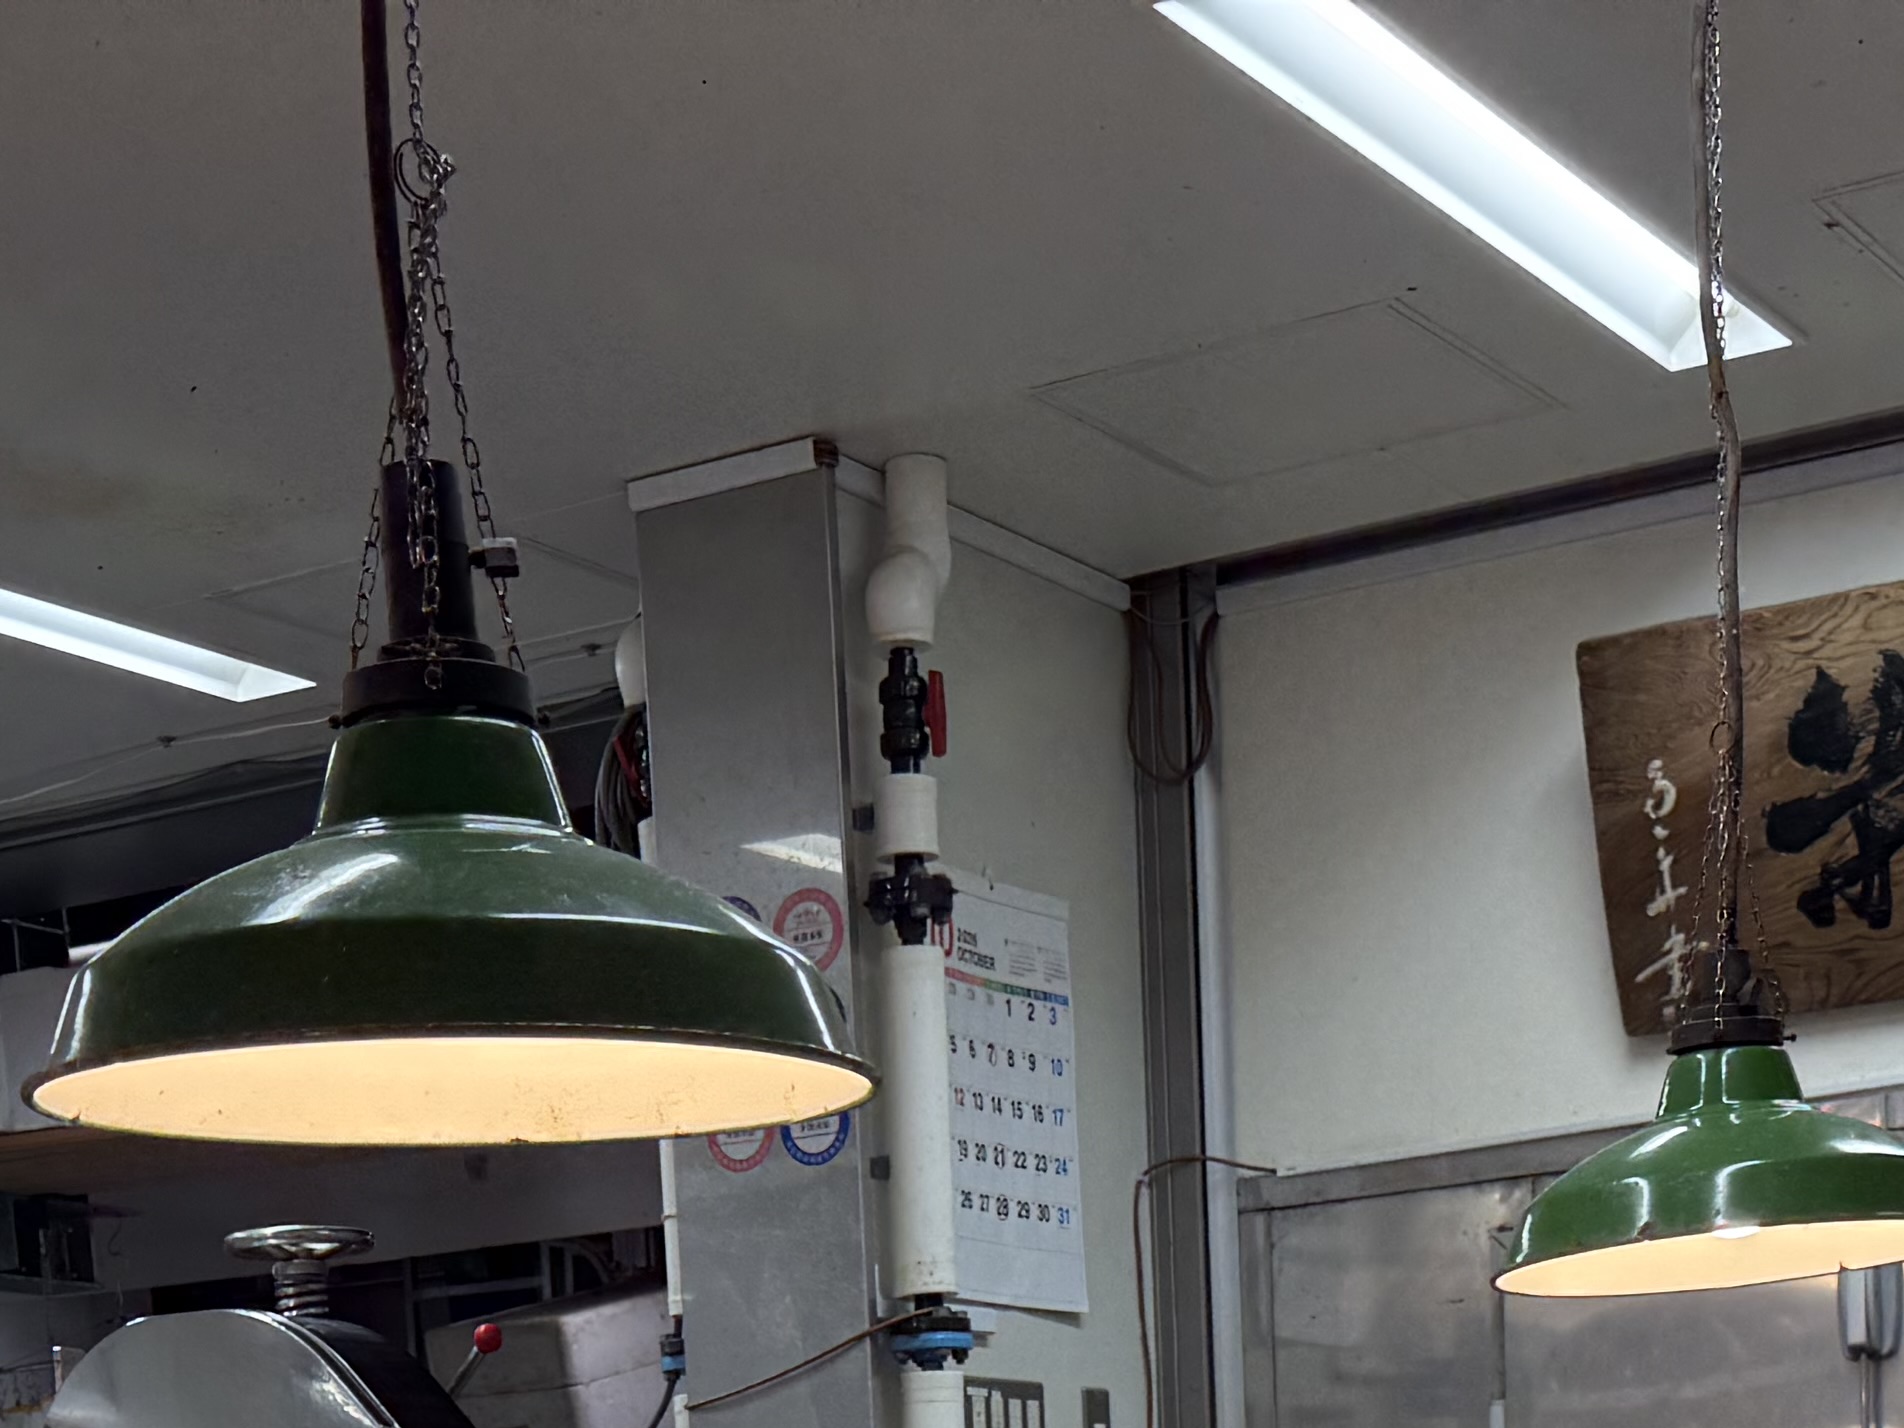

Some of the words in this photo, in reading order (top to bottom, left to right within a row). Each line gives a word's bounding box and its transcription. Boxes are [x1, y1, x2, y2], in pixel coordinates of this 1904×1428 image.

[1006, 998, 1012, 1017] 1
[1027, 1002, 1035, 1021] 2
[1049, 1006, 1057, 1025] 3
[949, 1034, 957, 1053] 5
[968, 1039, 976, 1058] 6
[987, 1043, 995, 1063] 7
[1007, 1049, 1015, 1067] 8
[1028, 1053, 1036, 1072] 9
[1051, 1058, 1063, 1077] 10
[954, 1087, 965, 1107] 12
[972, 1092, 983, 1111] 13
[991, 1096, 1002, 1115] 14
[1011, 1101, 1023, 1120] 15
[1032, 1104, 1044, 1123] 16
[1052, 1108, 1064, 1126] 17
[957, 1139, 968, 1159] 19
[975, 1142, 987, 1162] 20
[994, 1146, 1005, 1167] 21
[1013, 1150, 1027, 1169] 22
[1034, 1153, 1047, 1173] 23
[1055, 1158, 1068, 1176] 24
[960, 1190, 973, 1209] 26
[979, 1193, 990, 1212] 27
[996, 1196, 1009, 1218] 28
[1017, 1200, 1030, 1219] 29
[1037, 1203, 1050, 1222] 30
[1057, 1207, 1070, 1225] 31
